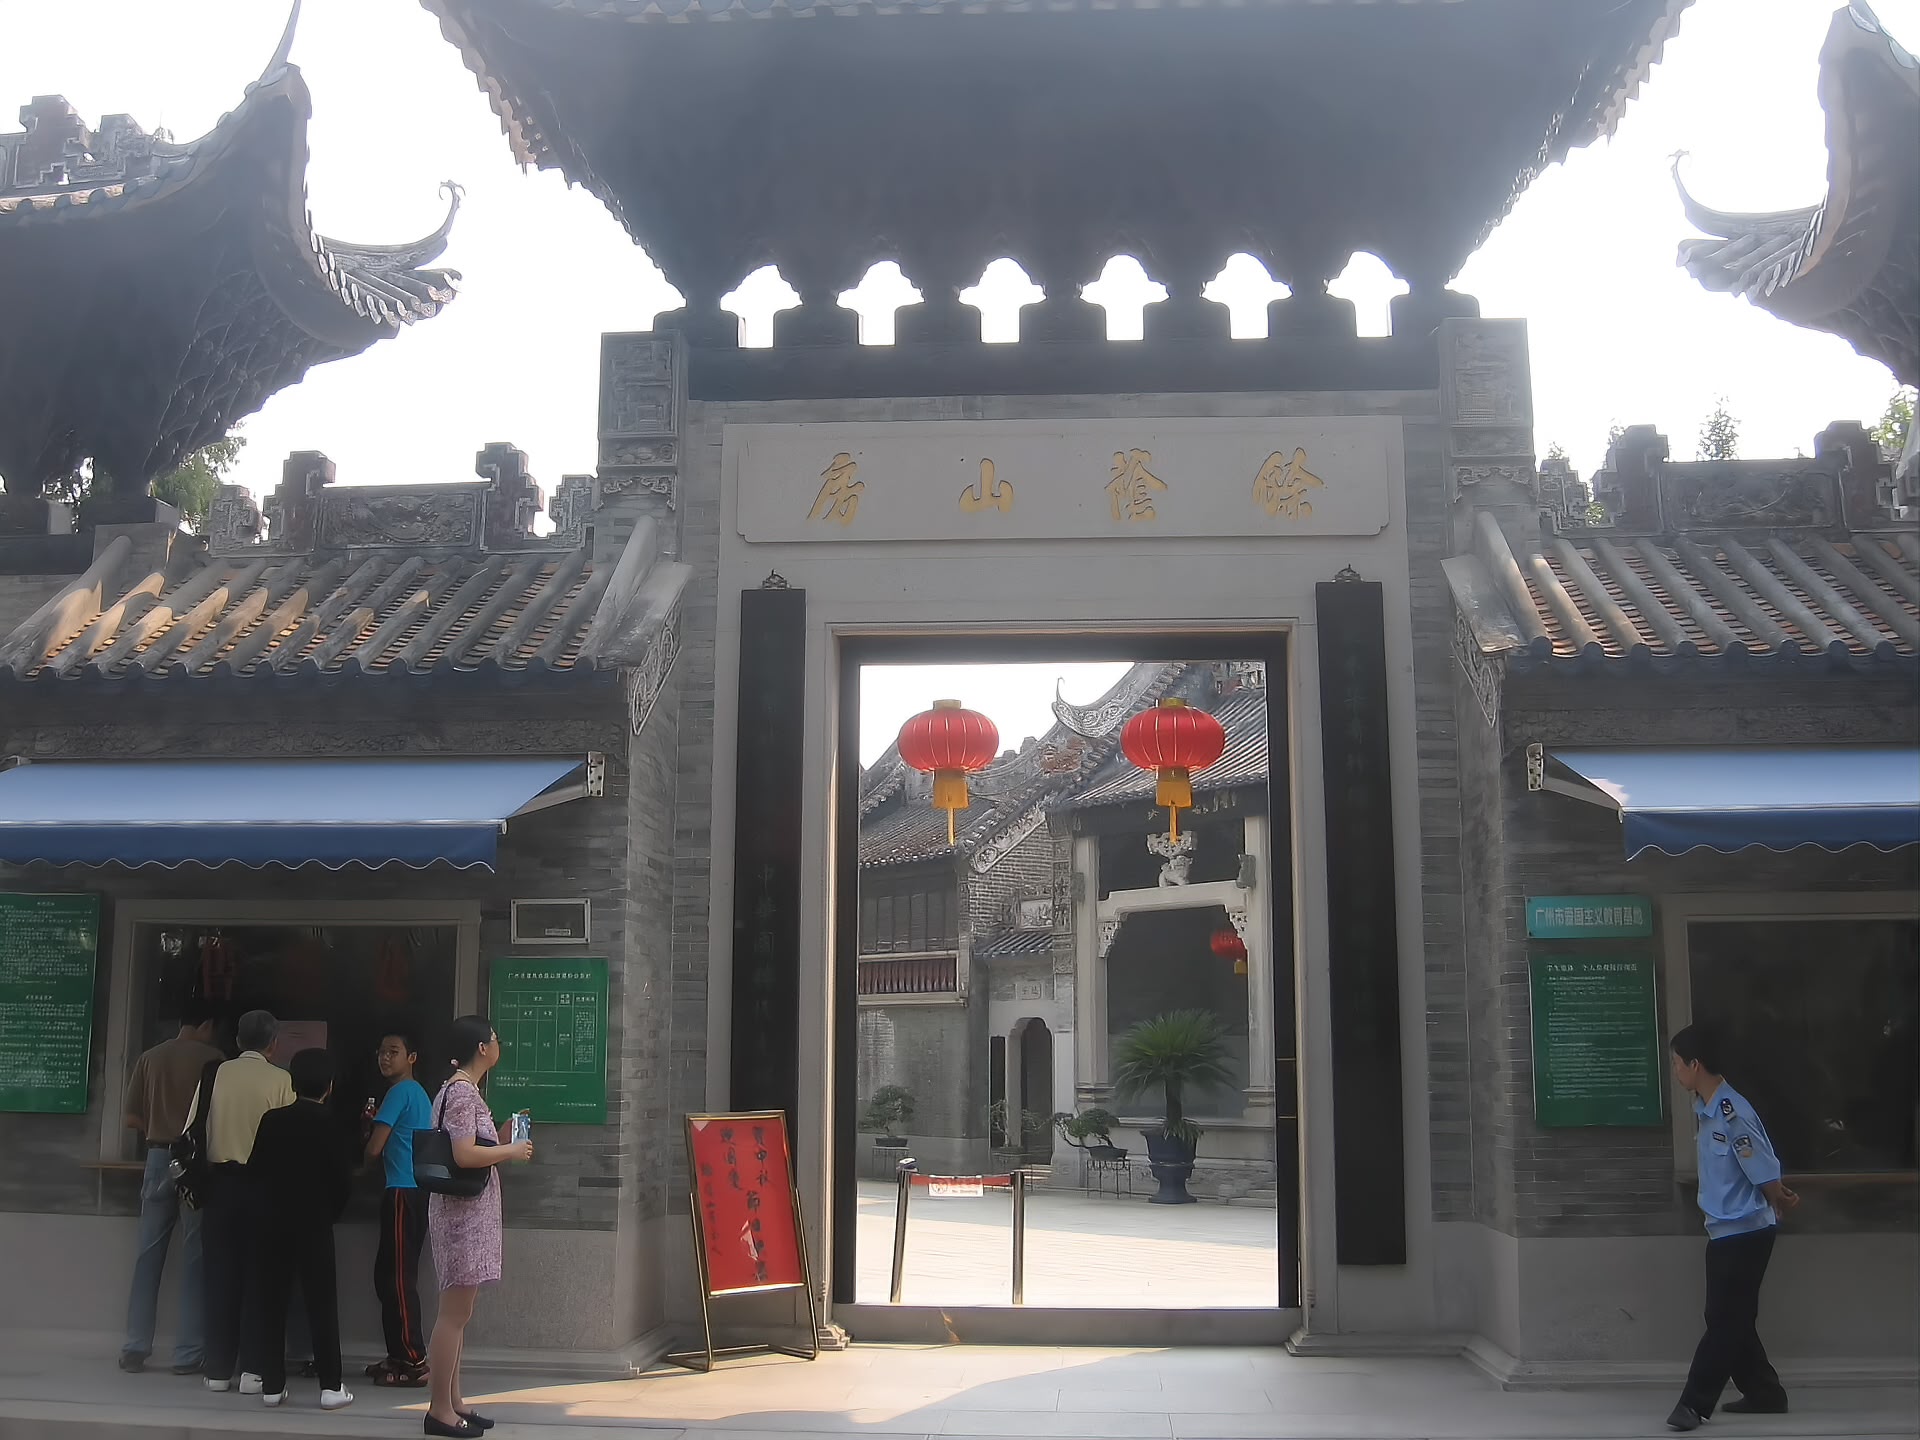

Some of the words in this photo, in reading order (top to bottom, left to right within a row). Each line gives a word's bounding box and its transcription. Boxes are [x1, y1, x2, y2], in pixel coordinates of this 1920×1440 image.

[1535, 907, 1643, 926] 广州市爱国主义教育基地
